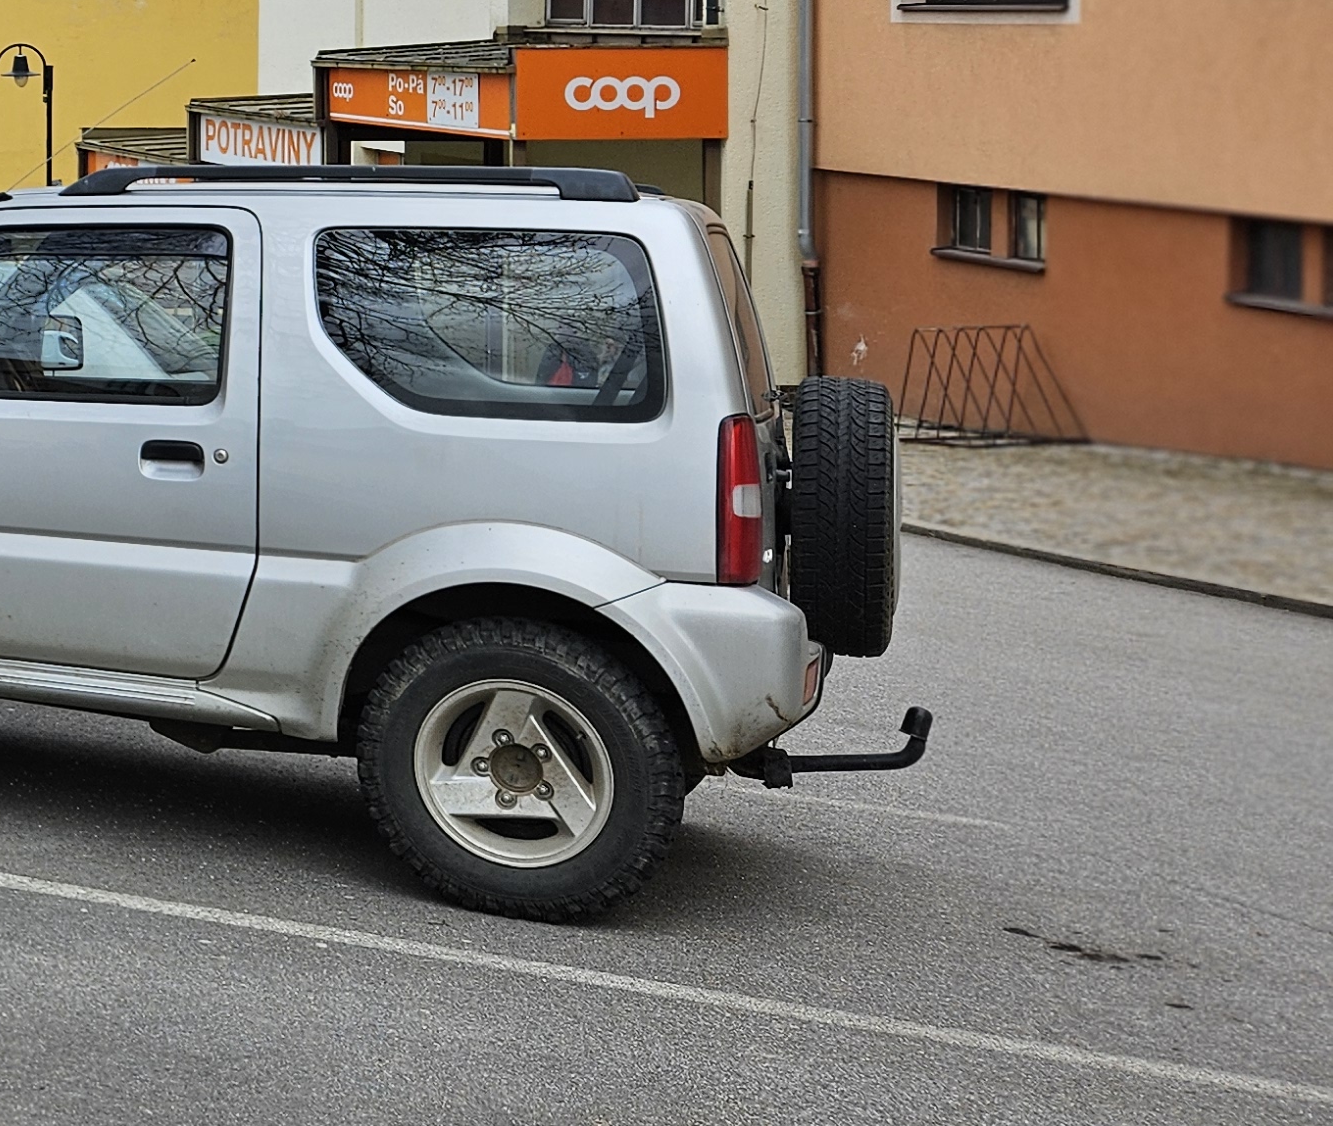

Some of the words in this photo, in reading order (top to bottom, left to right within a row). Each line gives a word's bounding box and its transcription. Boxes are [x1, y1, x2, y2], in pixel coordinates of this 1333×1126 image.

[332, 81, 354, 102] coop
[388, 73, 425, 95] Po-Pá
[388, 95, 405, 116] So
[564, 76, 681, 119] coop
[205, 118, 317, 166] POTRAVINY
